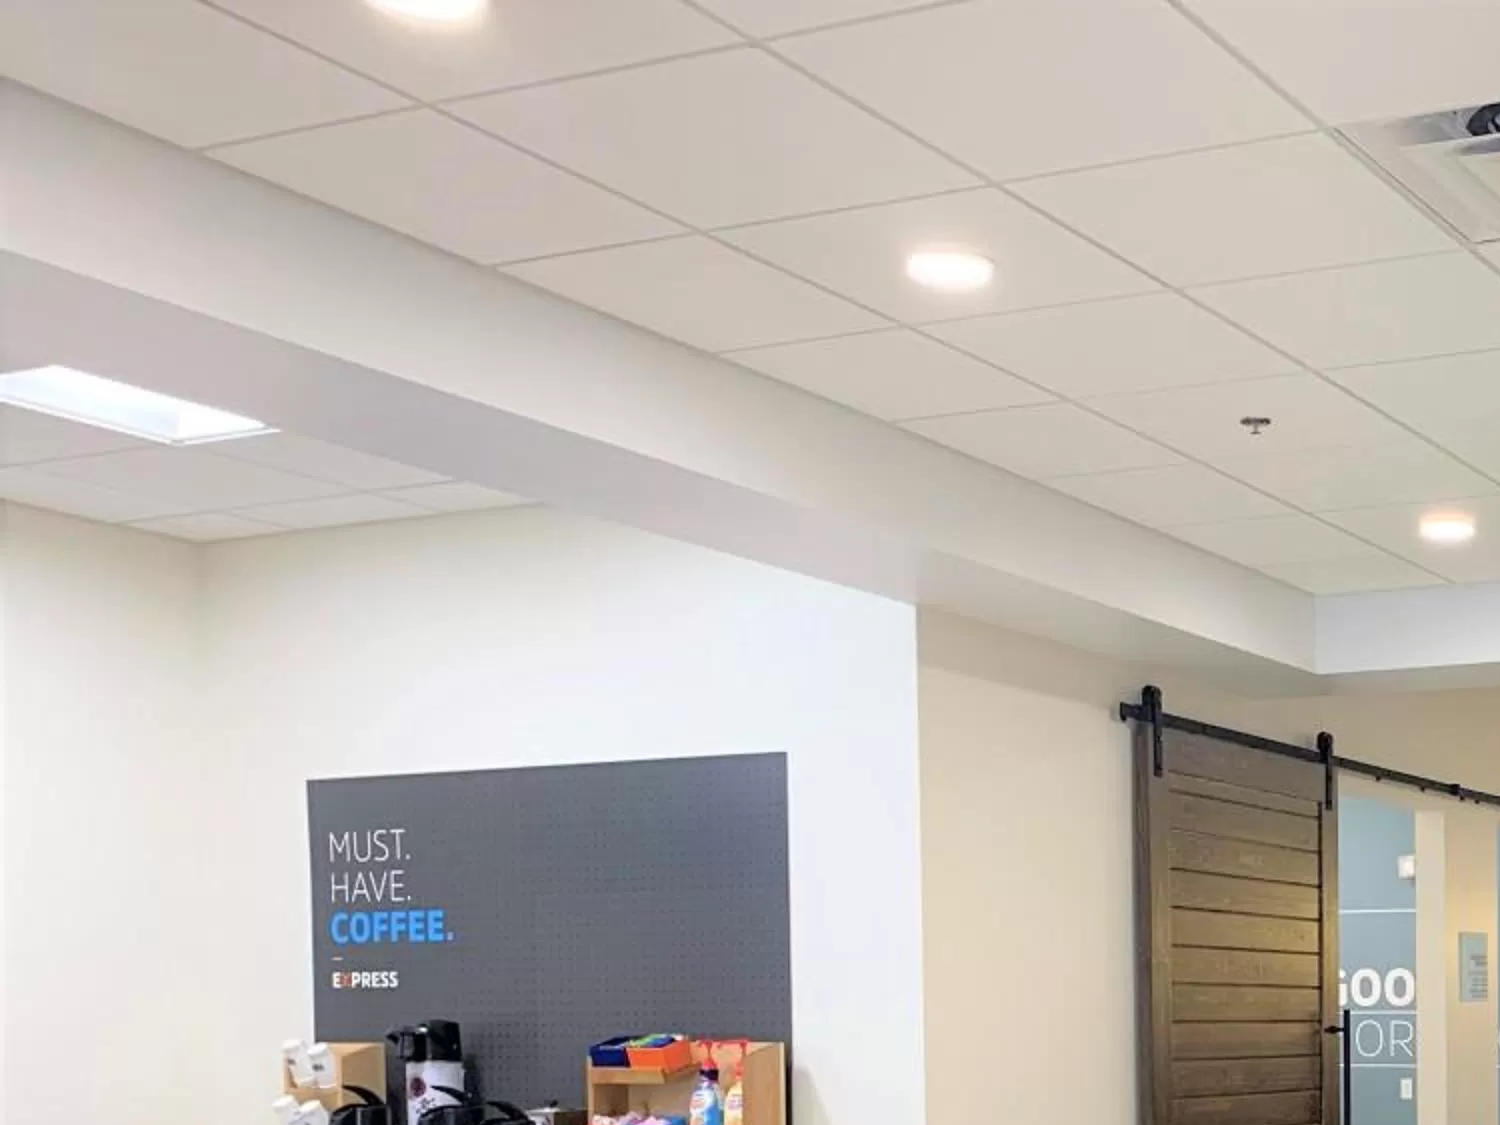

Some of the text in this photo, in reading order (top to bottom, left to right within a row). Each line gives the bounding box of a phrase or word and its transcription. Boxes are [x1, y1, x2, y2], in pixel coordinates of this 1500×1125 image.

[328, 828, 412, 864] MUST.
[330, 869, 412, 903] HAVE.
[330, 908, 454, 945] COFFEE.
[331, 971, 399, 989] EXPRESS
